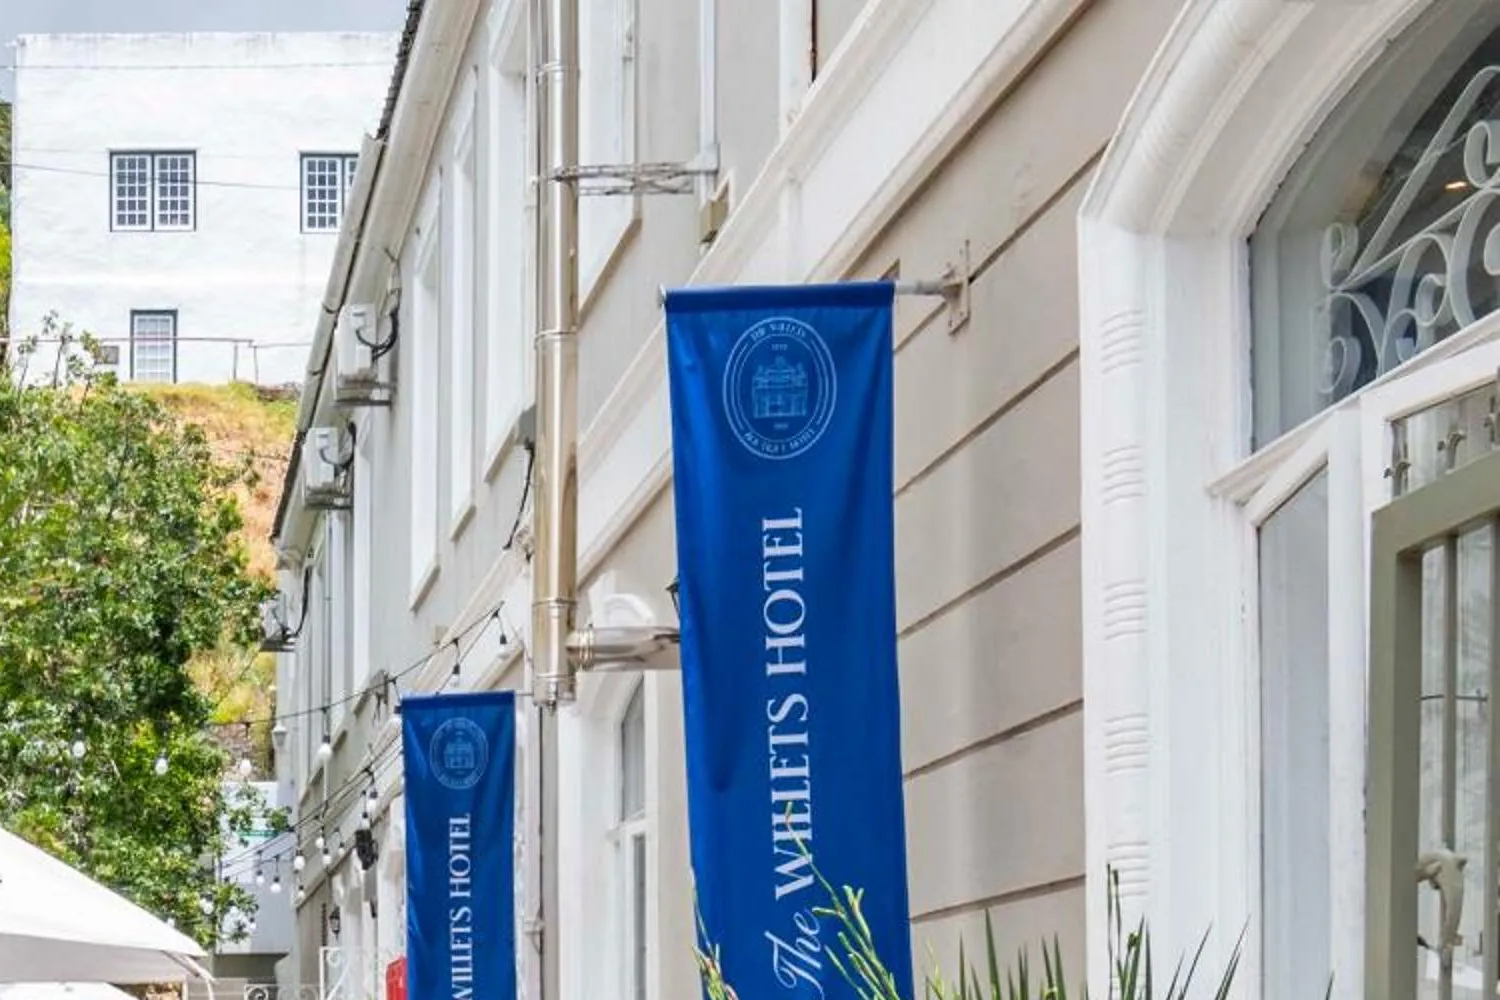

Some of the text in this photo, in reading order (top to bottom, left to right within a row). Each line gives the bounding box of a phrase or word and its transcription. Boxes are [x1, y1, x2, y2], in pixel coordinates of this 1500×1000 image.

[762, 507, 806, 677] HOTEL
[449, 813, 471, 898] HOTEL
[766, 693, 815, 900] WILLETS
